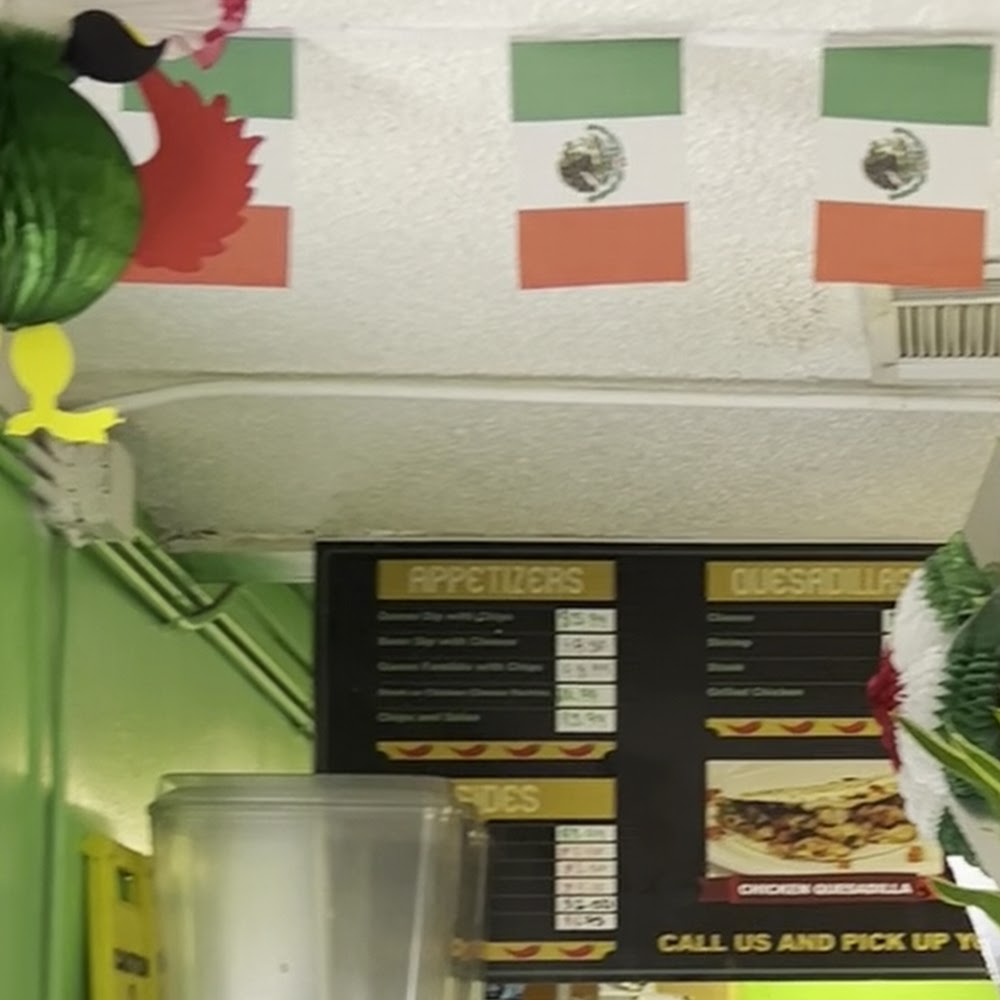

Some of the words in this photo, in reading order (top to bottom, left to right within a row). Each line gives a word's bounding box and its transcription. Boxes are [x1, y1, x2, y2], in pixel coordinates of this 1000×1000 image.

[408, 565, 585, 594] APPETIZERS
[454, 783, 541, 813] SIDES
[736, 883, 811, 896] CHICKEN
[657, 933, 729, 953] CALL
[733, 933, 773, 952] US
[777, 932, 837, 952] AND
[841, 932, 905, 952] PICK
[911, 932, 951, 951] UP
